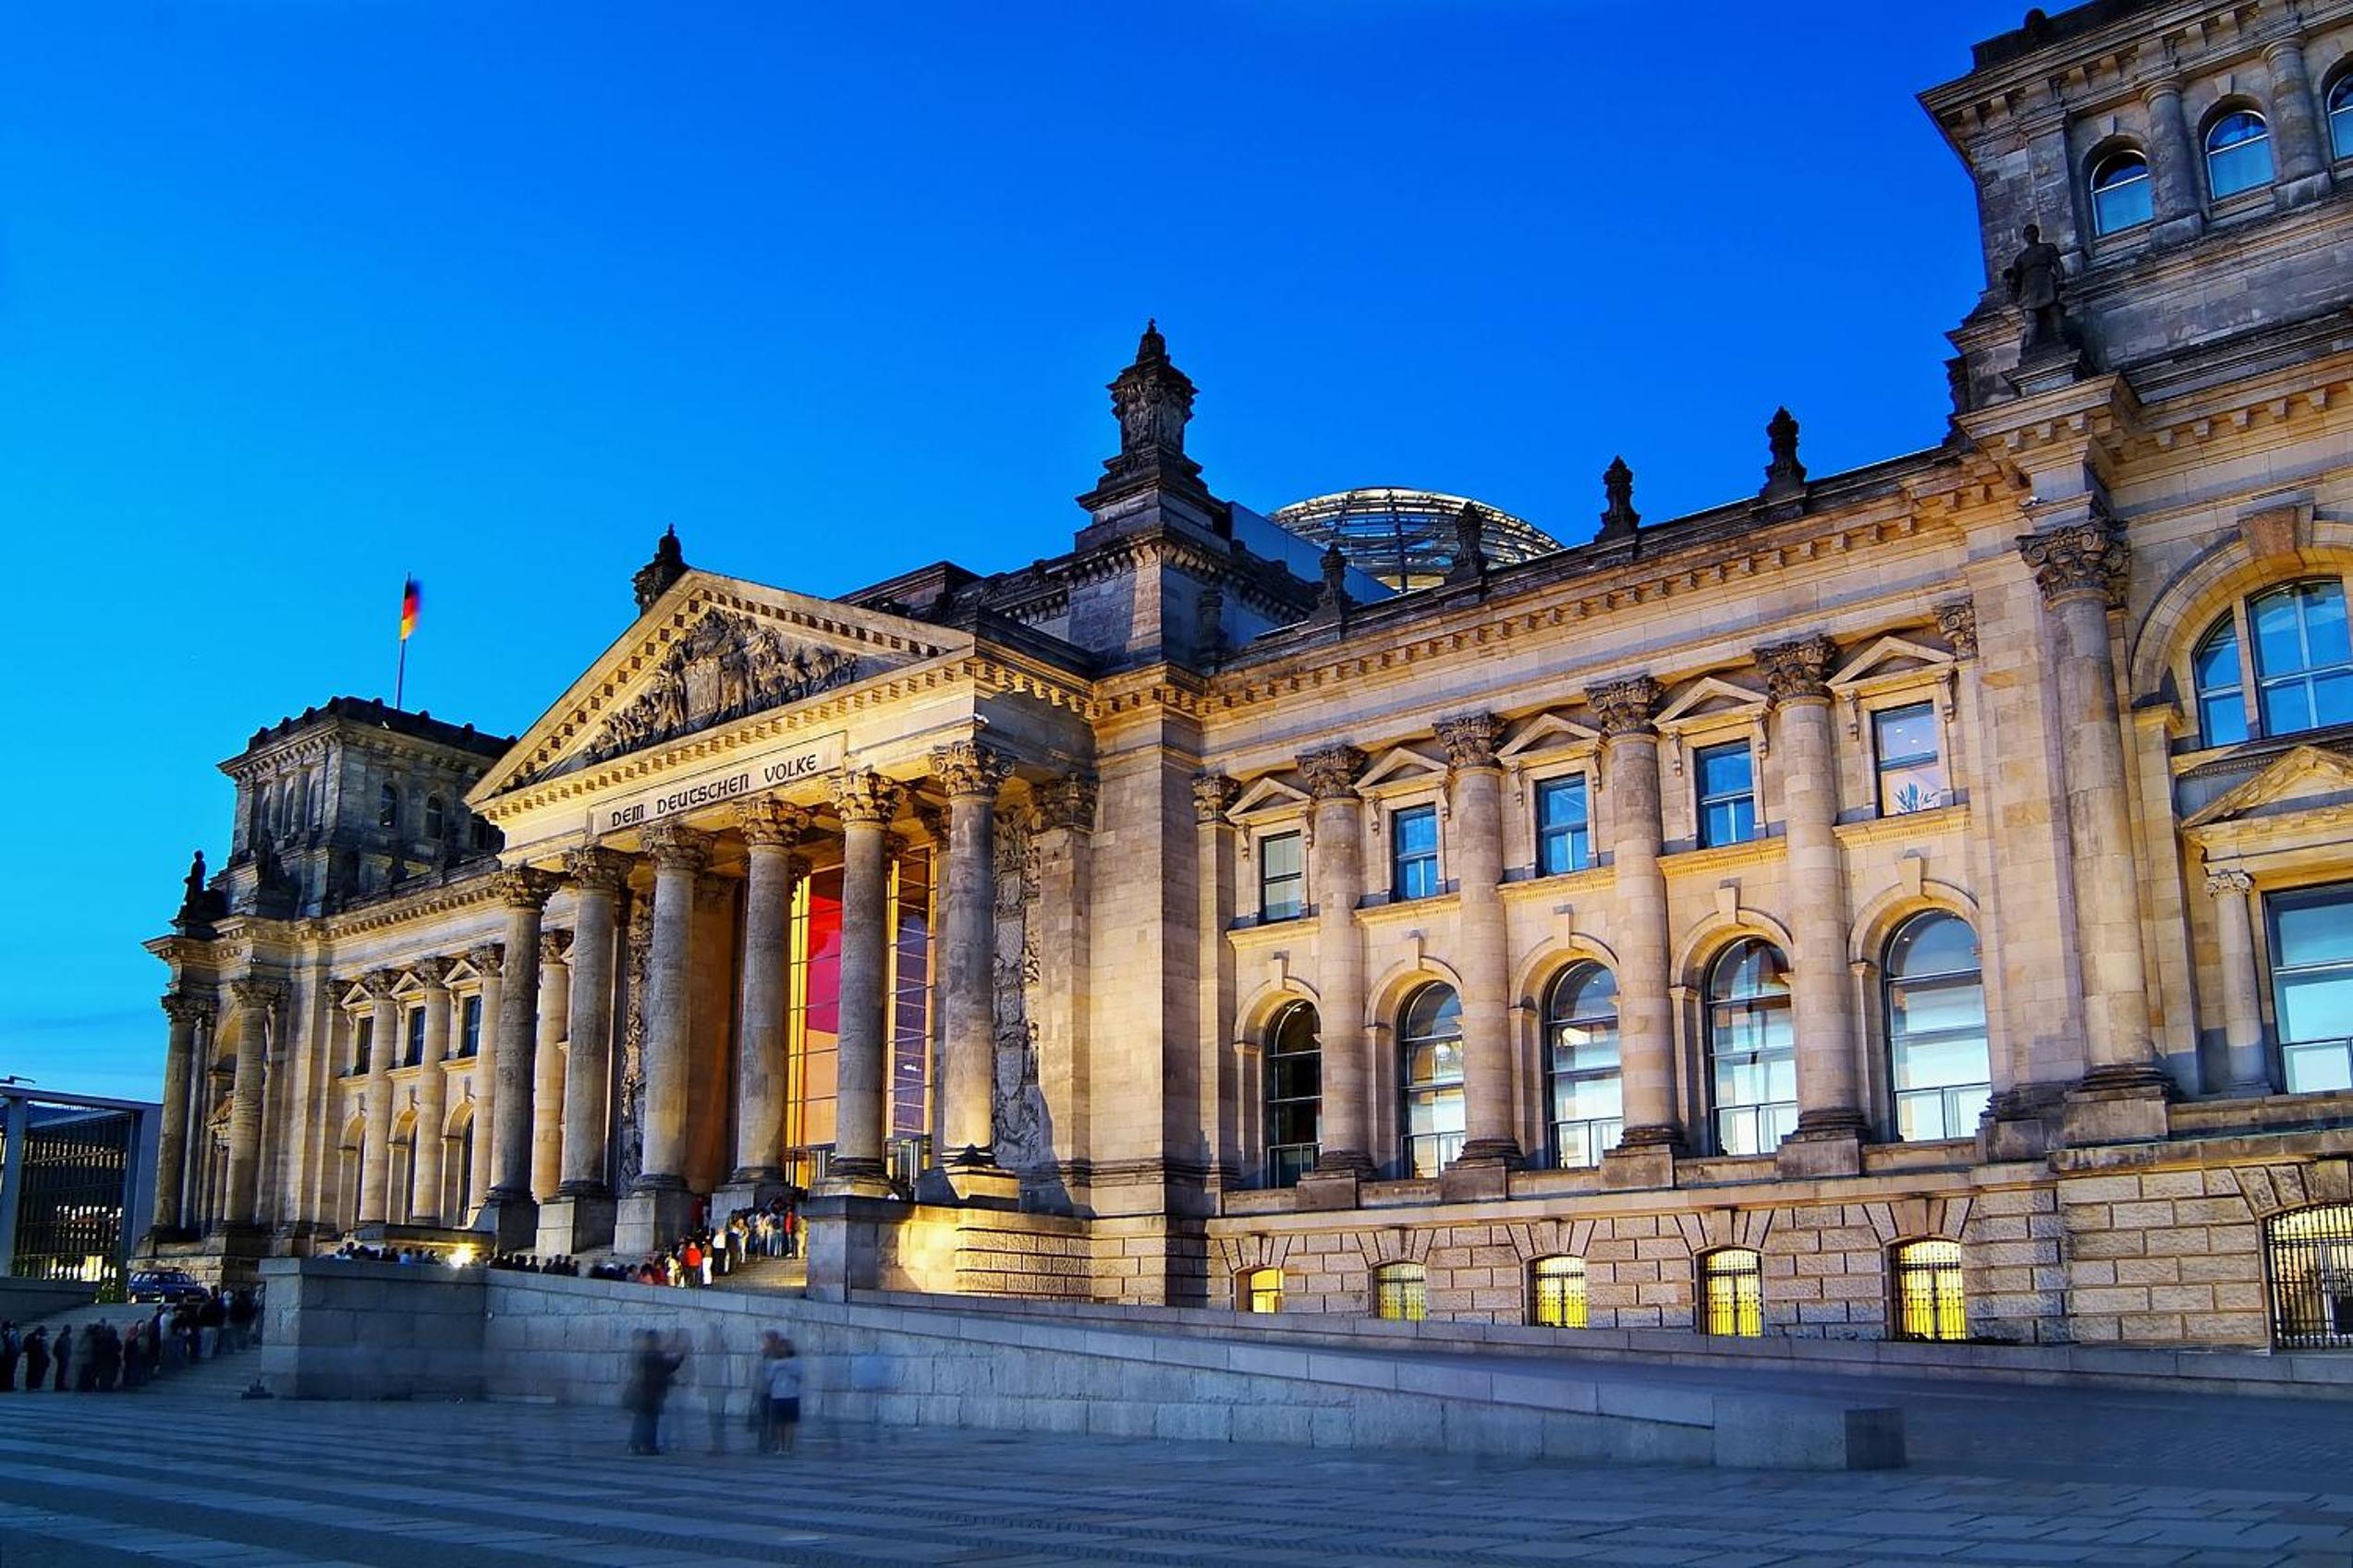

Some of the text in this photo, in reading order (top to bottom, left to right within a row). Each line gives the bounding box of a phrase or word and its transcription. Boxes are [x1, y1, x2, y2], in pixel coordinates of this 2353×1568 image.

[612, 754, 817, 827] DEM DEUTSCHEN VOLKE
